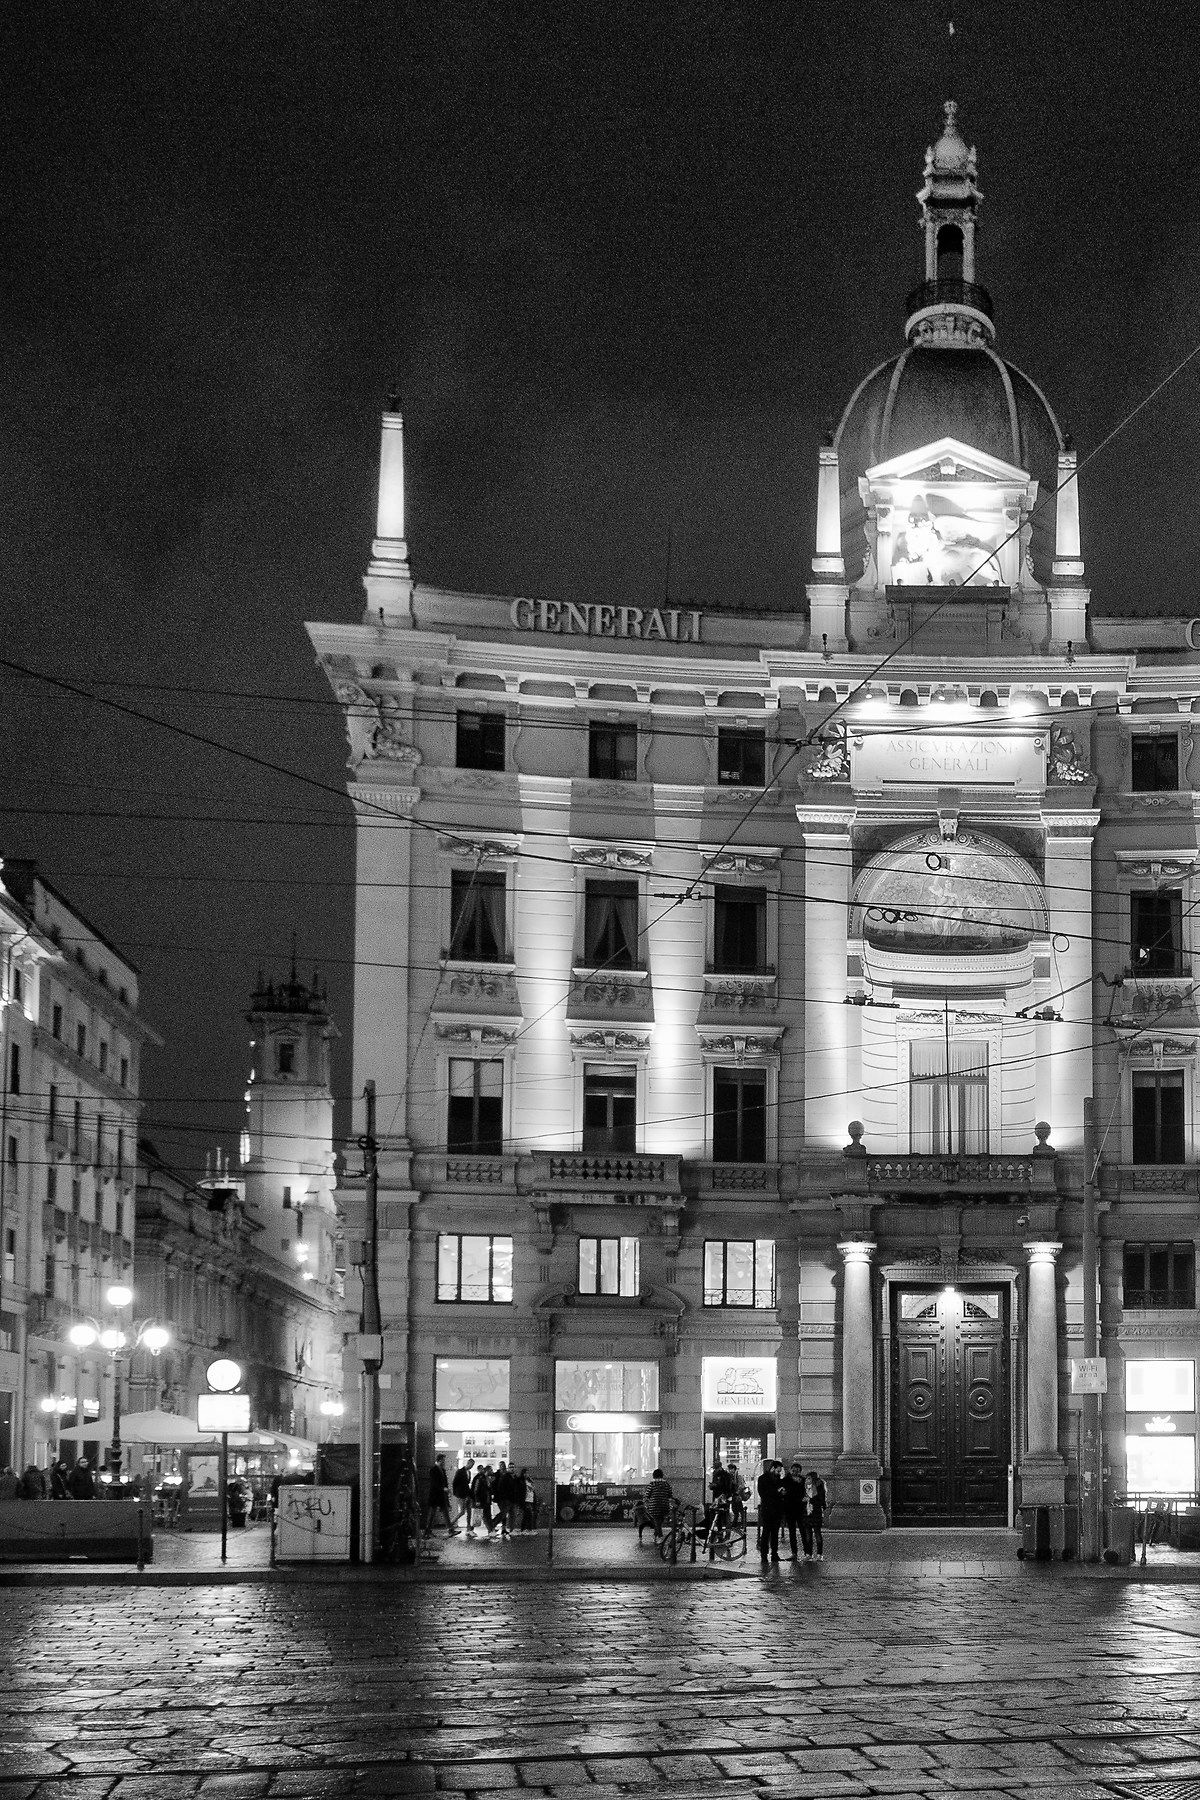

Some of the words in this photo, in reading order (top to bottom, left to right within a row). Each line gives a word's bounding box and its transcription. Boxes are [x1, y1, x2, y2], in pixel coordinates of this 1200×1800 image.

[510, 598, 703, 642] GENERALI
[909, 757, 989, 771] GENERALI
[717, 1396, 764, 1405] GENERALI
